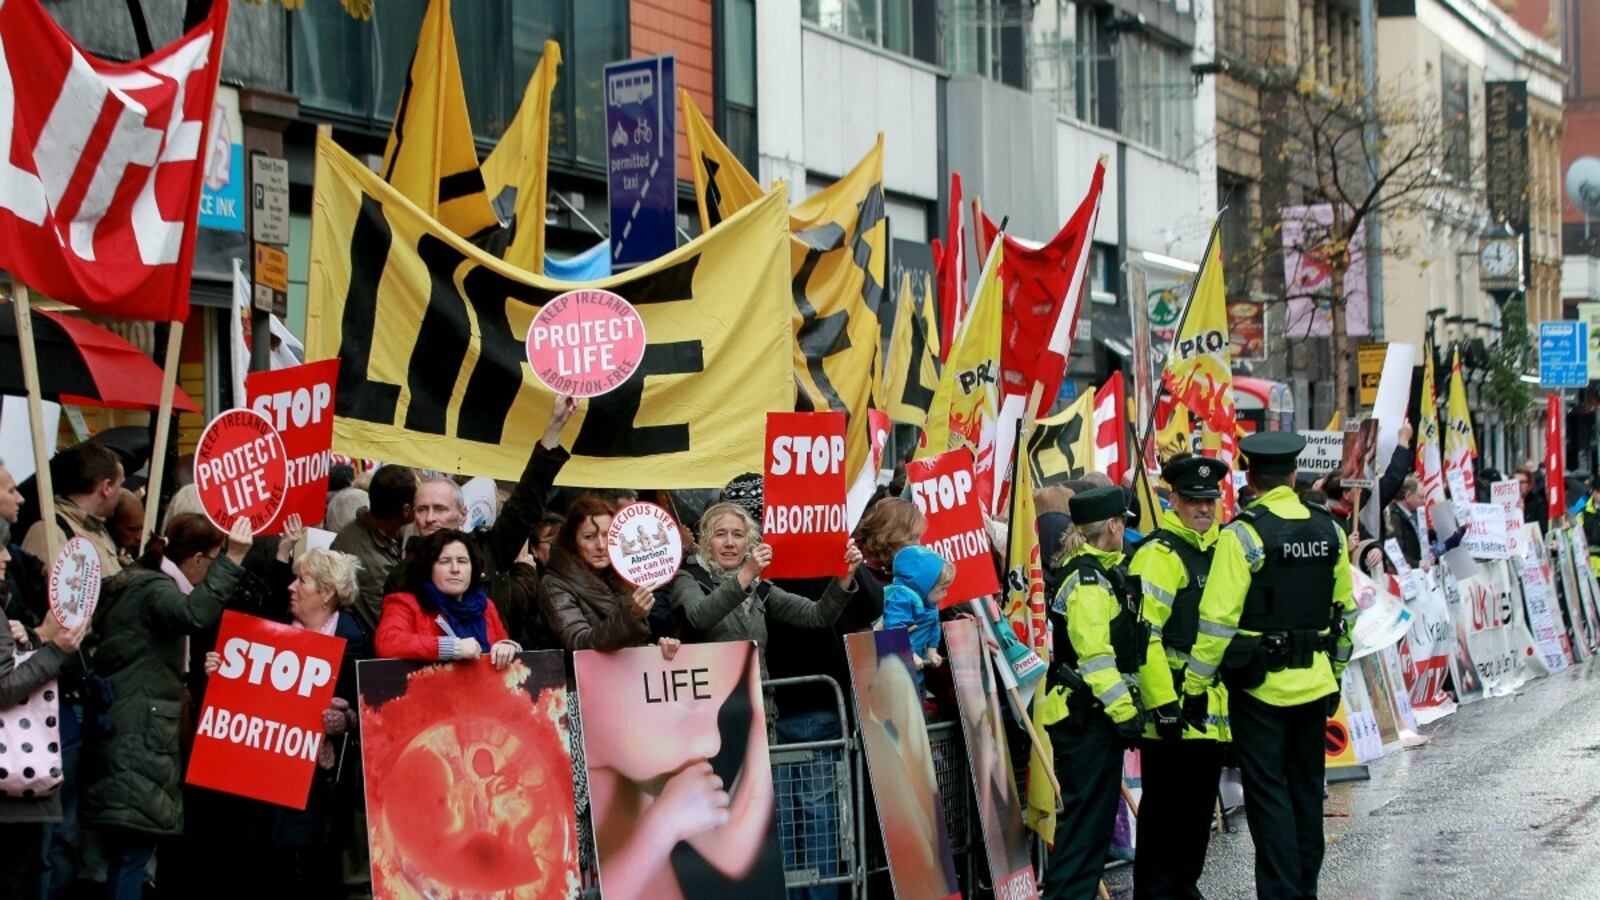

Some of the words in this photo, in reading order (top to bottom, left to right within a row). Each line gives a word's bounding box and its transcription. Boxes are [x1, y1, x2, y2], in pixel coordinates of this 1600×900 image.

[611, 151, 650, 174] permitted
[623, 173, 638, 190] taxi
[216, 197, 236, 218] INK
[335, 191, 703, 457] LIFE
[539, 297, 569, 324] KEEP
[576, 292, 630, 316] IRELAND
[534, 316, 636, 350] PROTECT
[541, 359, 636, 394] ABORTION-FREE
[558, 344, 616, 376] LIFE
[252, 382, 331, 432] STOP
[199, 424, 219, 459] KEEP
[223, 414, 268, 434] IRELAND
[770, 435, 845, 476] STOP
[1317, 446, 1327, 456] is
[198, 432, 277, 491] PROTECT
[287, 449, 332, 489] RTION
[222, 468, 271, 515] LIFE
[911, 470, 973, 515] STOP
[609, 505, 652, 546] PRECIOUS
[654, 509, 676, 531] LIFE
[628, 566, 642, 575] we
[643, 561, 658, 570] can
[660, 555, 674, 565] live
[631, 547, 668, 565] Abortion?
[1283, 541, 1329, 558] POLICE
[51, 559, 67, 624] PRECIOUS
[63, 540, 81, 558] LIFE
[79, 562, 90, 610] Abortion?
[633, 569, 667, 583] without
[668, 566, 675, 574] it
[218, 637, 332, 698] STOP
[643, 667, 712, 703] LIFE
[197, 705, 322, 762] ABORTION
